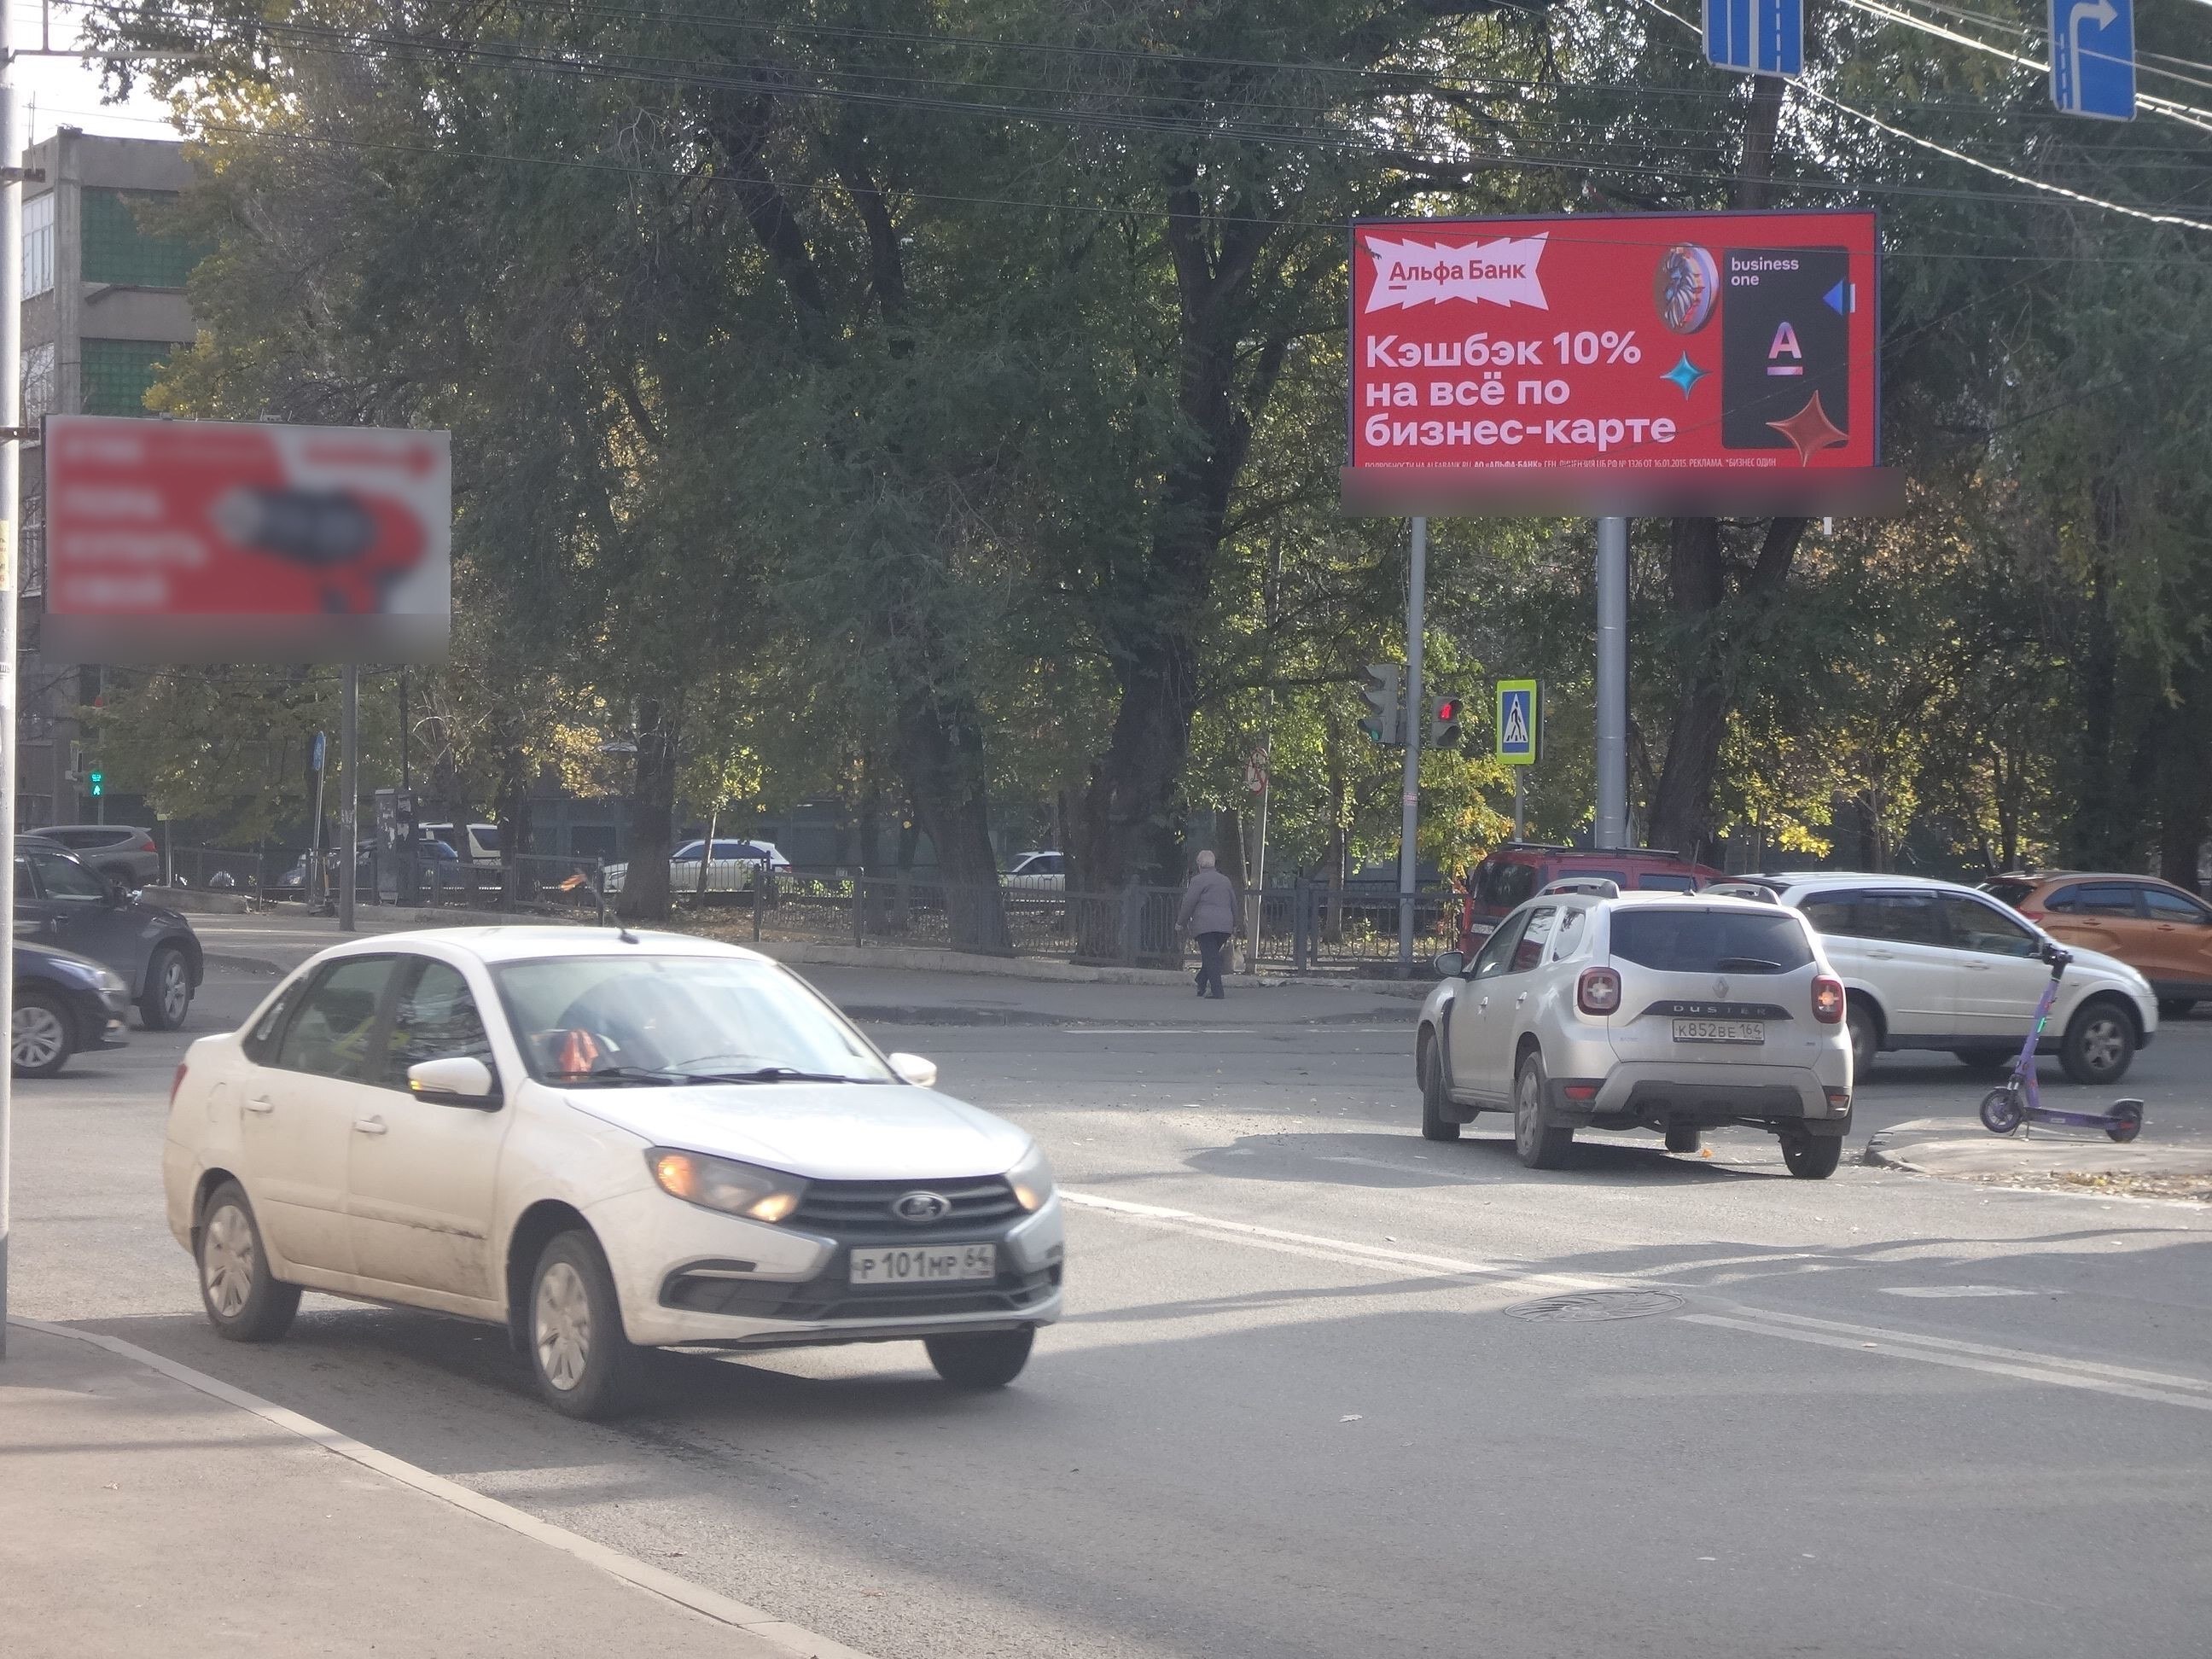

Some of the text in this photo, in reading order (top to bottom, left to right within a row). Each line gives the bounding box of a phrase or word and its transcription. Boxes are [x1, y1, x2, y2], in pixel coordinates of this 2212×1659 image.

[1388, 259, 1526, 285] Альфа Банк
[1732, 257, 1799, 271] business
[1731, 276, 1760, 286] one
[1366, 330, 1642, 368] Кэшбэк 10%
[1366, 371, 1570, 407] на всё по
[1365, 413, 1676, 451] бизнес-карте
